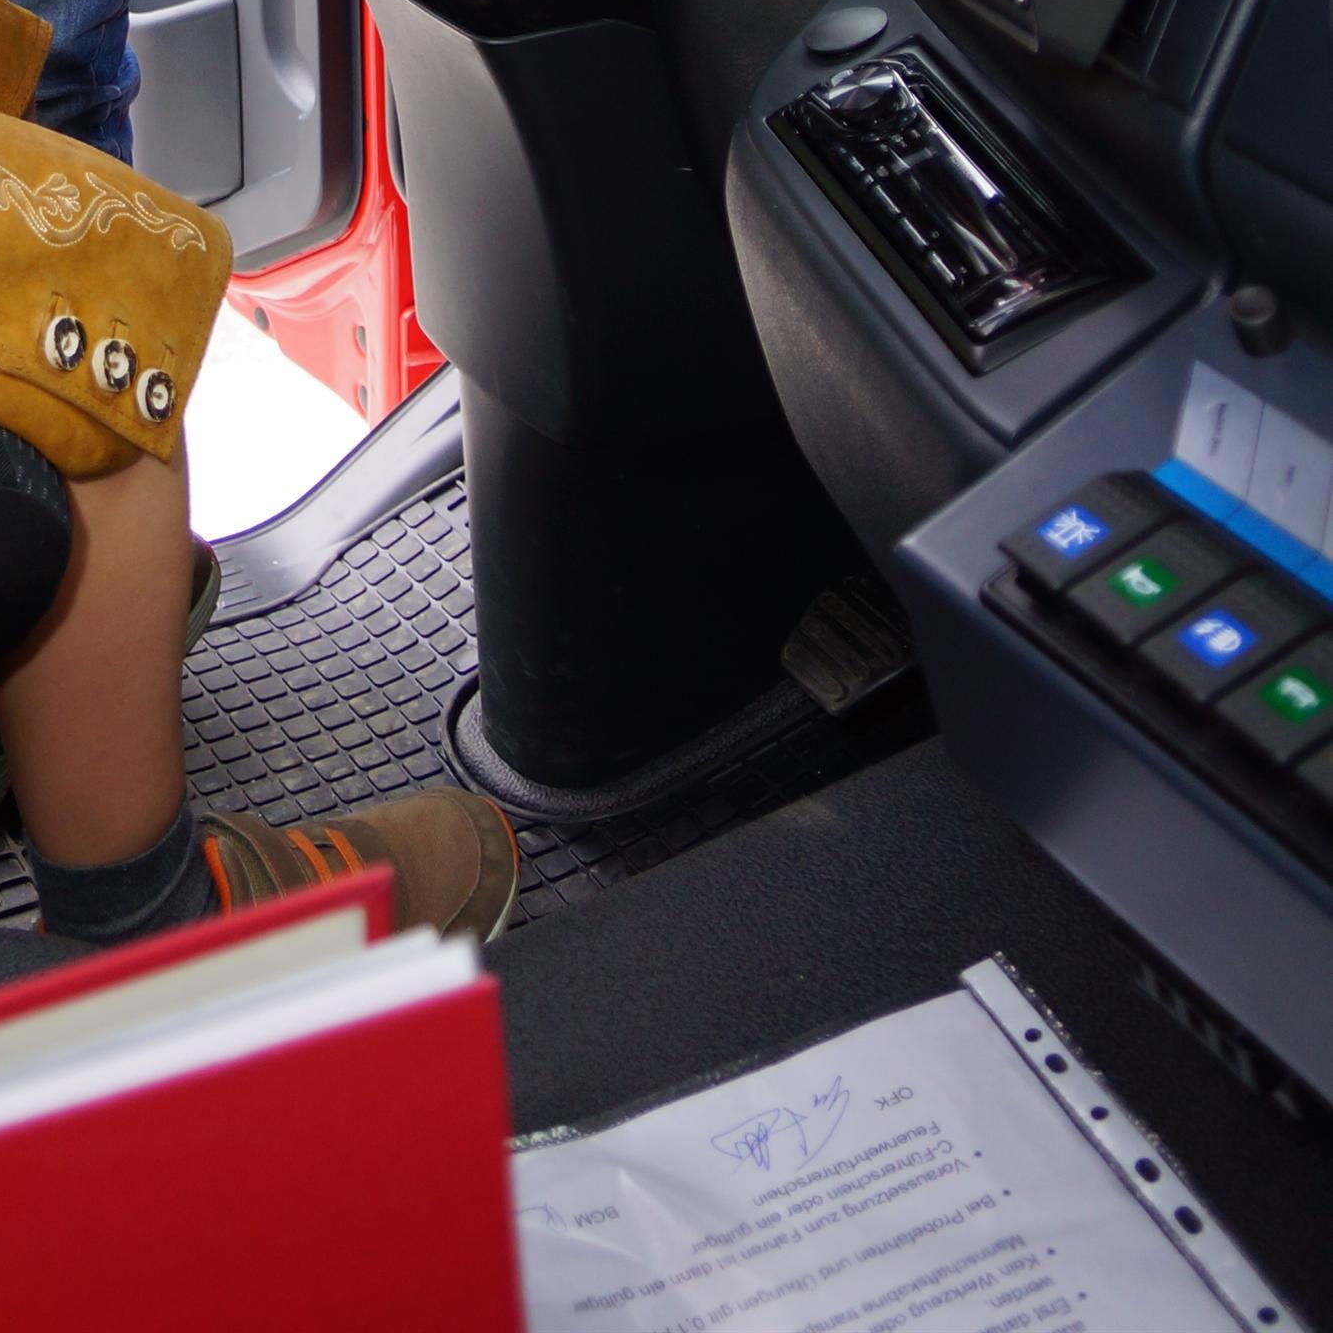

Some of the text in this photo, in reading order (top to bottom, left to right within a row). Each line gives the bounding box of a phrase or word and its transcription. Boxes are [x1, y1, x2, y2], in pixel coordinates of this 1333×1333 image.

[874, 1086, 914, 1111] OFK
[752, 1120, 942, 1208] Feuerwehrführerschein
[826, 1139, 953, 1201] C-Führerschein
[841, 1158, 969, 1218] Voraussetzung
[573, 1205, 620, 1228] BGM
[787, 1193, 825, 1218] oder
[965, 1194, 996, 1217] Bei
[756, 1212, 782, 1230] ein
[803, 1212, 841, 1234] zum
[739, 1228, 802, 1261] Fahren
[855, 1209, 965, 1263] Probefahrten
[668, 1259, 713, 1287] dann
[819, 1257, 853, 1280] und
[861, 1234, 1027, 1312] Mannschaftskabine
[999, 1253, 1041, 1276] Kein
[639, 1278, 667, 1297] ein
[908, 1272, 999, 1318] Werkzeug
